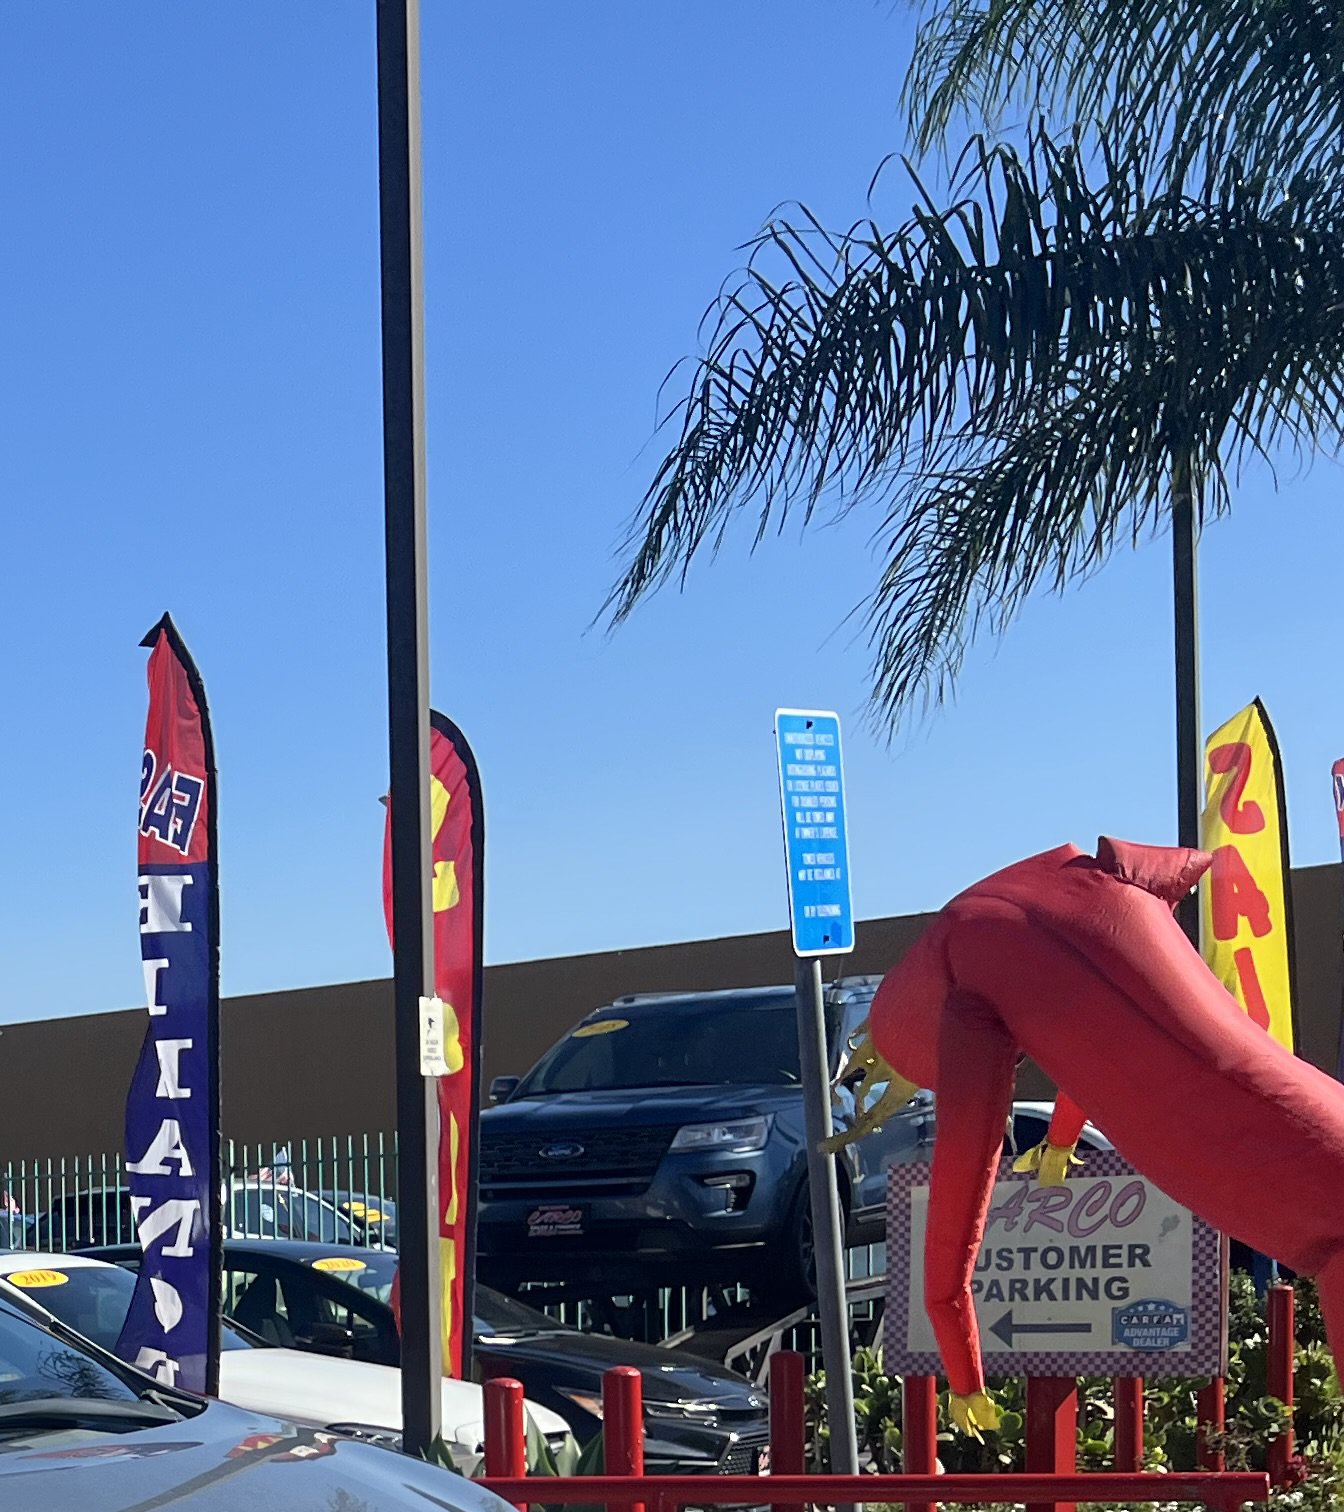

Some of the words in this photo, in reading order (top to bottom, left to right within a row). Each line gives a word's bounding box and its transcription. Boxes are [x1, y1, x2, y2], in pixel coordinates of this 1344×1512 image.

[987, 1180, 1146, 1239] ARCO
[974, 1243, 1153, 1272] USTOMER
[1123, 1327, 1180, 1337] ADVANTAGE
[1132, 1337, 1170, 1347] DEALER
